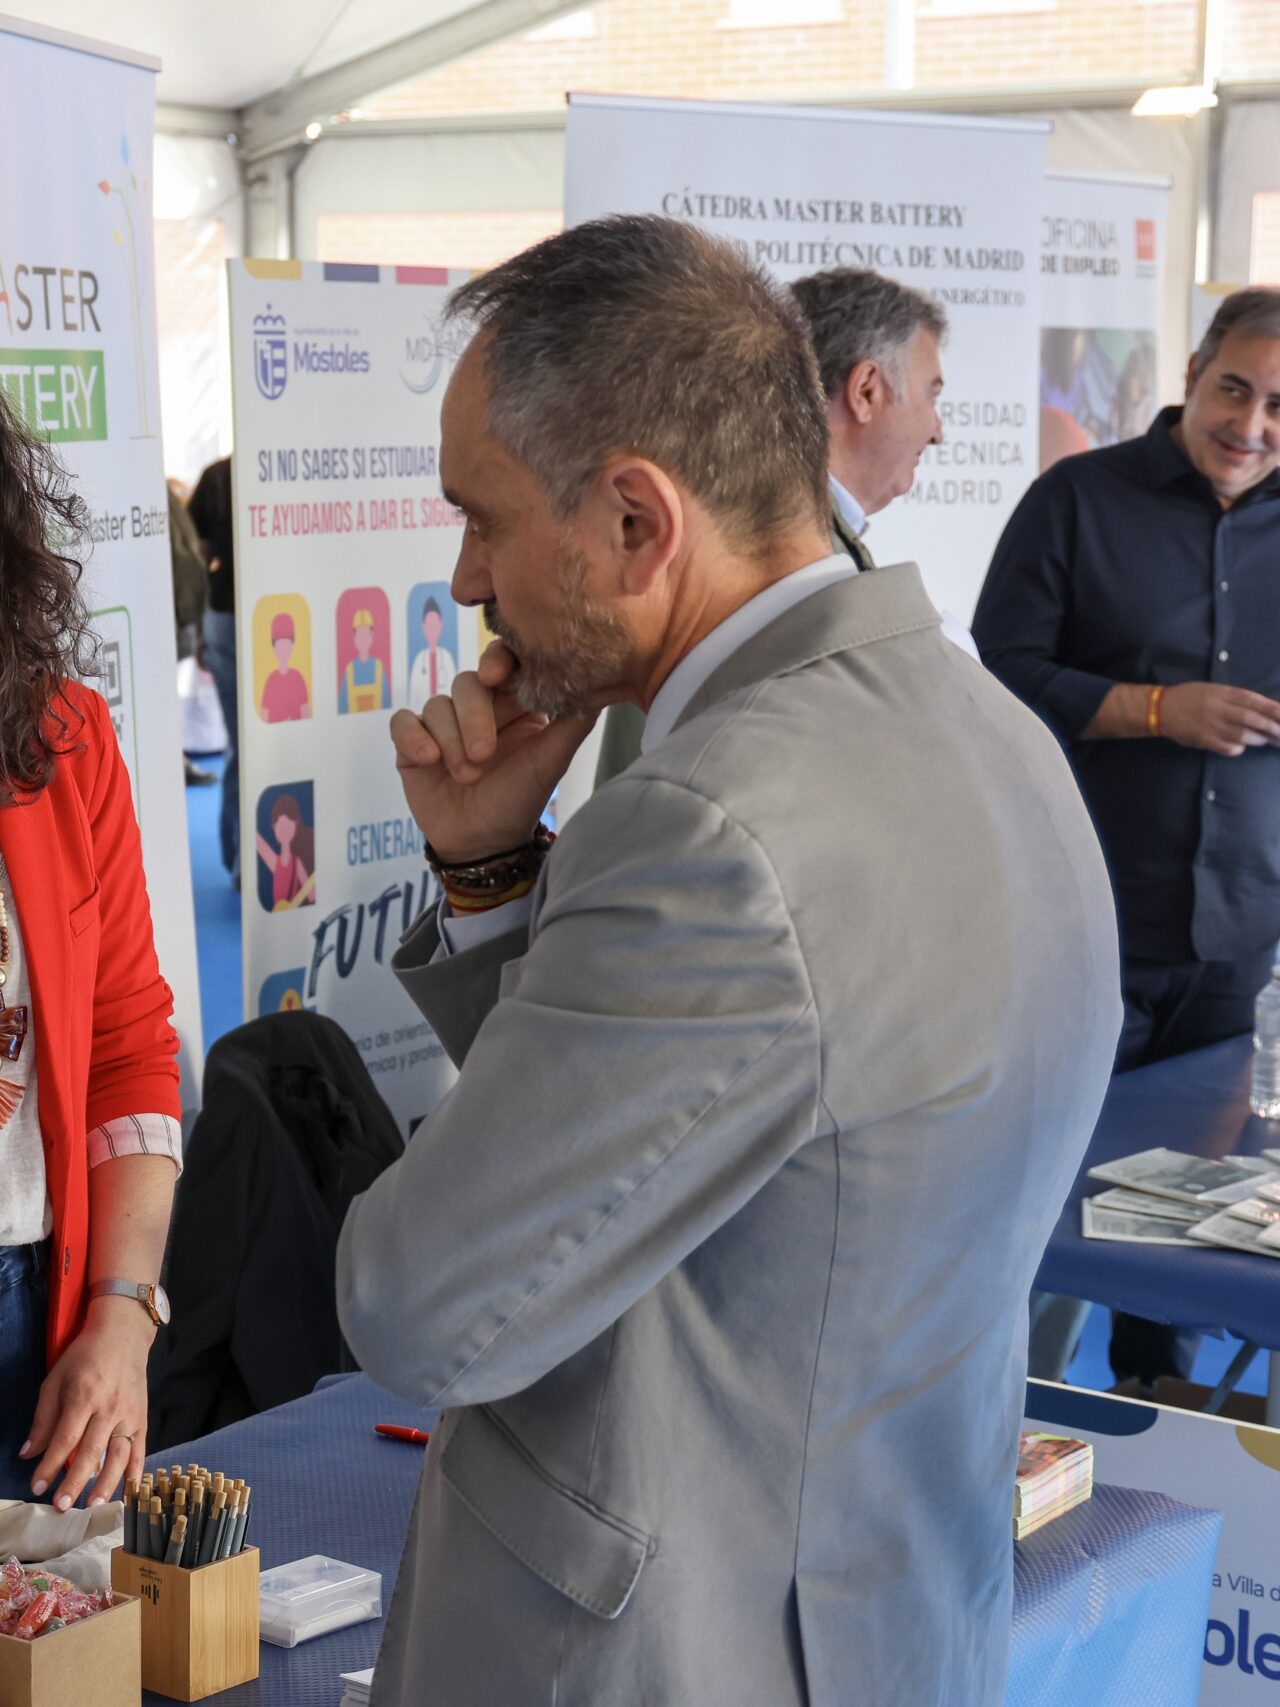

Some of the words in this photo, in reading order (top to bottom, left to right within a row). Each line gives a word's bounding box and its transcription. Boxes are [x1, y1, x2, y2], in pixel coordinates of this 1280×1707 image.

[662, 186, 767, 219] CÁTEDRA
[772, 197, 865, 223] MASTER
[870, 201, 966, 227] BATTERY
[755, 236, 904, 268] POLITÉCNICA
[908, 246, 936, 268] DE
[942, 246, 1025, 271] MADRID
[294, 342, 370, 373] Móstoles
[939, 401, 1026, 428] RSIDAD
[258, 449, 272, 482] SI
[277, 448, 297, 481] NO
[302, 447, 349, 480] SABES
[353, 447, 366, 479] SI
[371, 445, 436, 478] ESTUDIAR
[248, 504, 268, 537] TE
[272, 500, 353, 536] AYUDAMOS
[356, 500, 367, 531] A
[370, 498, 397, 530] DAR
[402, 498, 417, 528] EL
[347, 816, 424, 867] GENERA
[308, 868, 442, 999] FUTU
[1226, 1571, 1265, 1598] Villa
